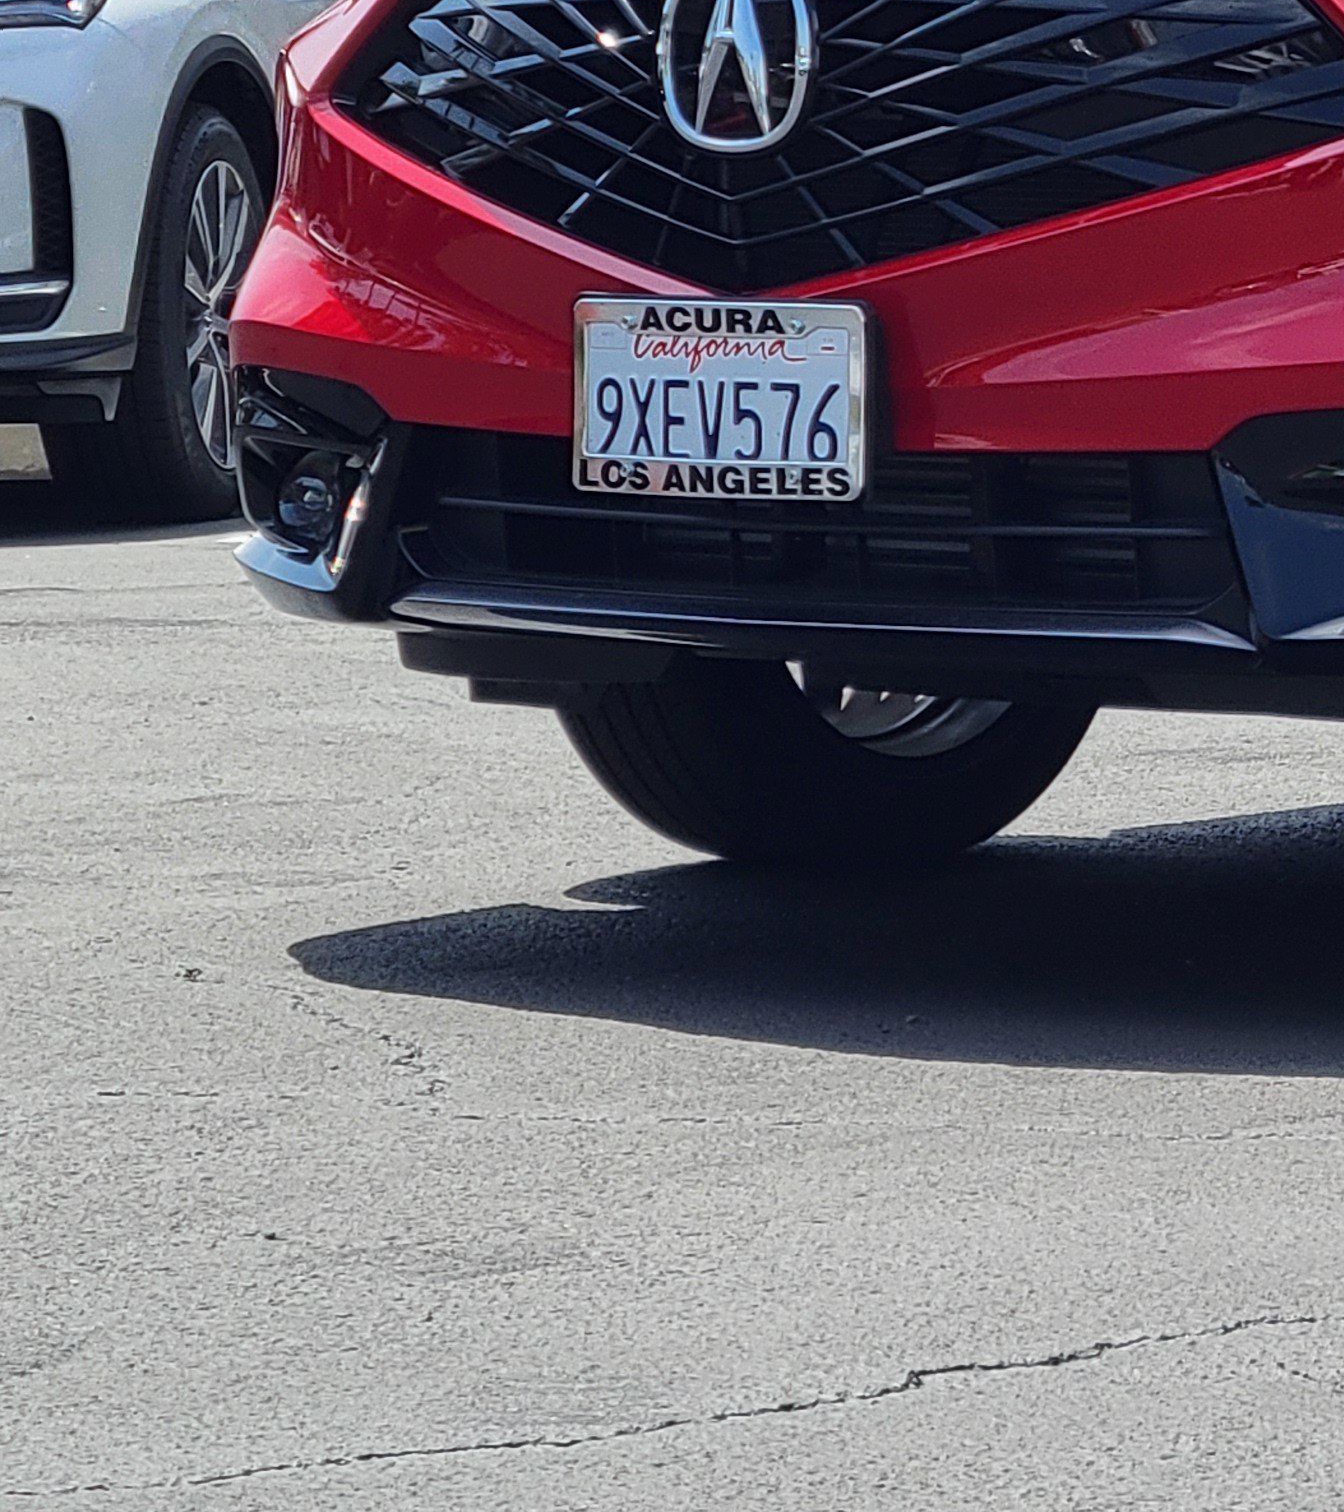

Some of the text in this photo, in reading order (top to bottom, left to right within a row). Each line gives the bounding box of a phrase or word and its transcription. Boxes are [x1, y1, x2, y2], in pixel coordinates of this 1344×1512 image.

[640, 306, 785, 335] ACURA
[632, 334, 808, 374] California
[596, 377, 842, 463] 9XEV576
[579, 458, 851, 498] LOS ANGELES
